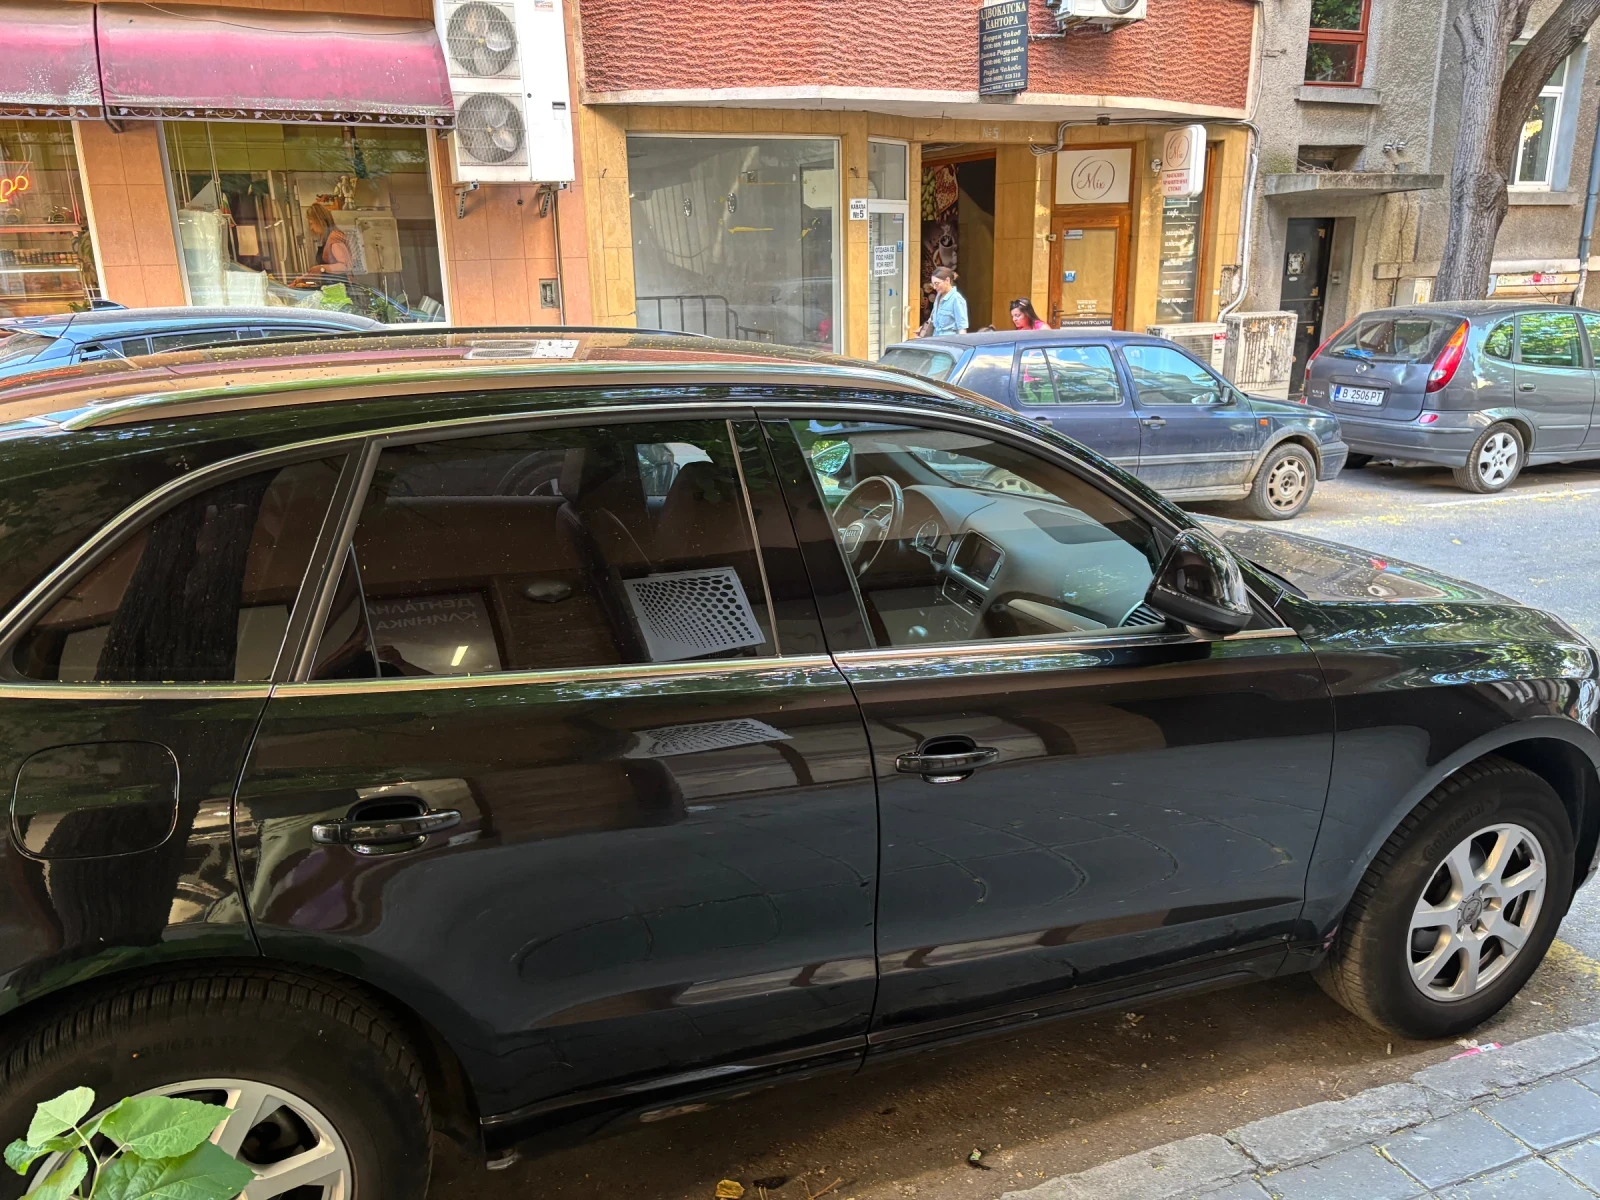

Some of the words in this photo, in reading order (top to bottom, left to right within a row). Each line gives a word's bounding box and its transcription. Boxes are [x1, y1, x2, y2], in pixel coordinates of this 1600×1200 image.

[985, 15, 1018, 30] КАНТОРА
[1076, 164, 1106, 190] Mix
[860, 209, 865, 219] 5
[1342, 388, 1349, 398] B
[1351, 390, 1370, 400] 2506
[1370, 391, 1382, 402] PT
